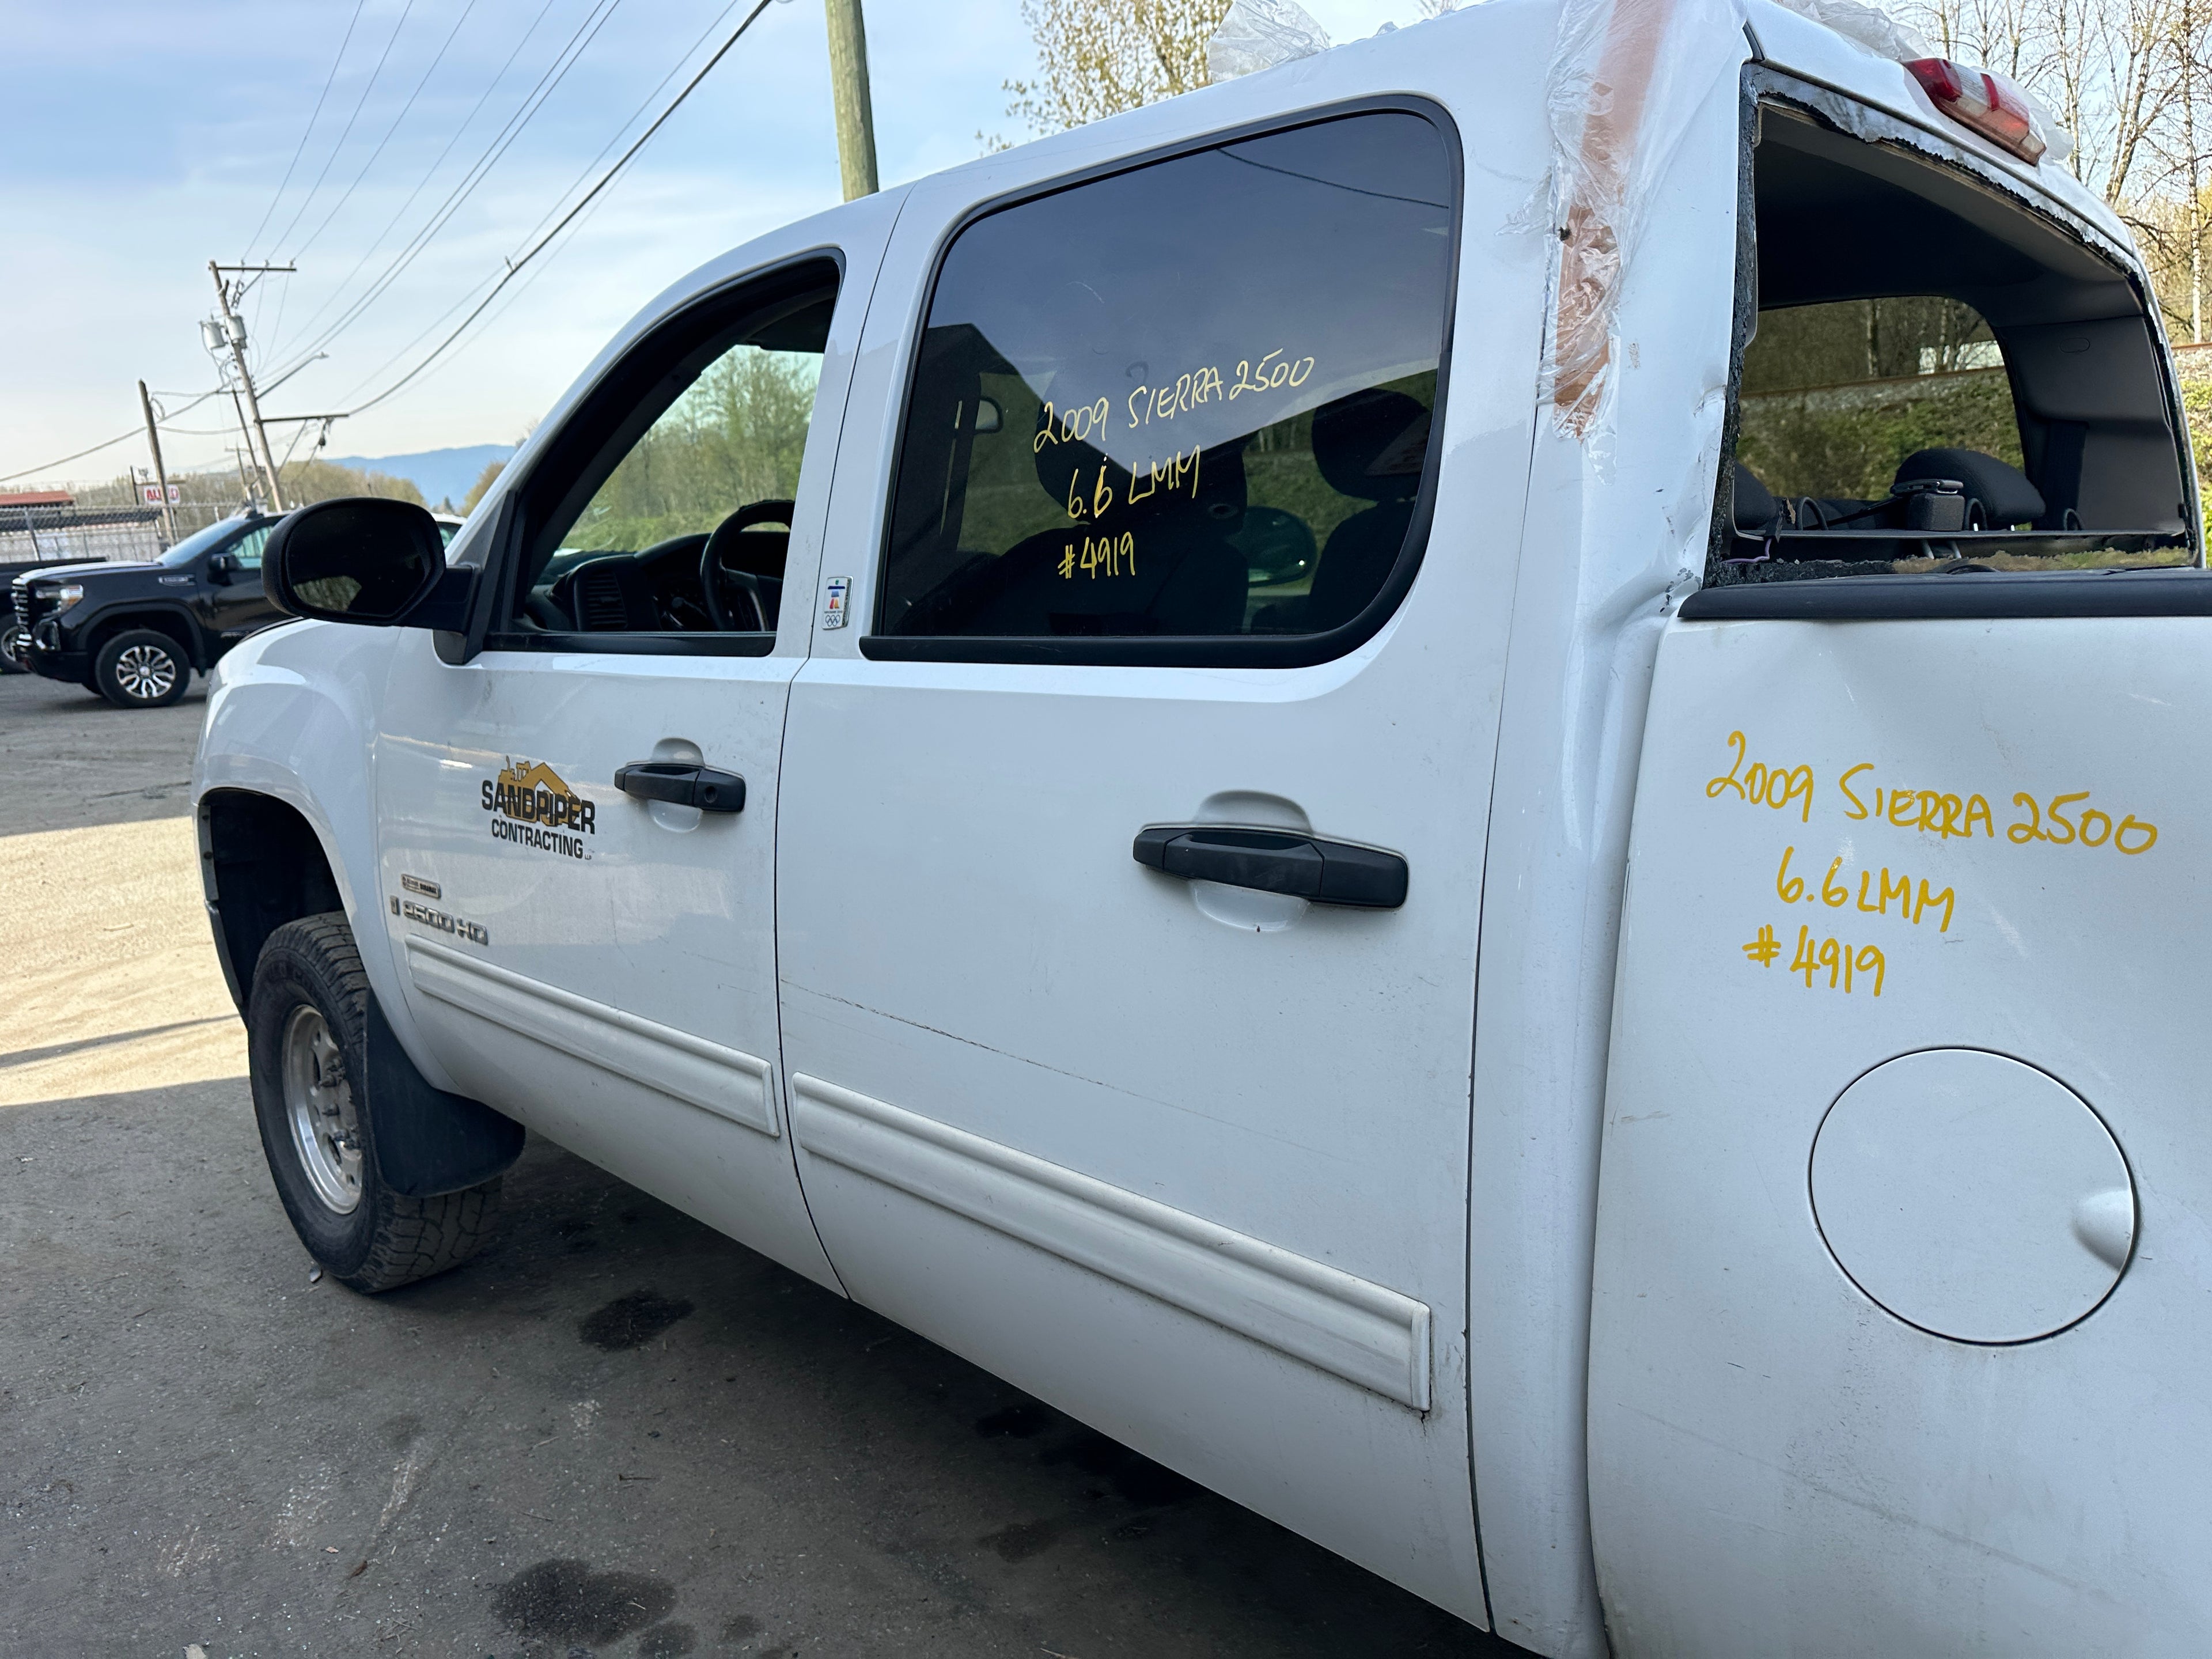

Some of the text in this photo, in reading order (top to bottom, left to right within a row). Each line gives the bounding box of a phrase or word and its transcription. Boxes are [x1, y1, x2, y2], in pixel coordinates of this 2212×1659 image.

[1033, 347, 1316, 453] 2009 SIERRA 2500
[1128, 444, 1202, 505] LMM
[1057, 532, 1137, 579] #4919
[482, 779, 596, 835] SANDPIPER
[1706, 730, 2158, 855] 2009 SIERRA 2500
[491, 818, 584, 859] CONTRACTING
